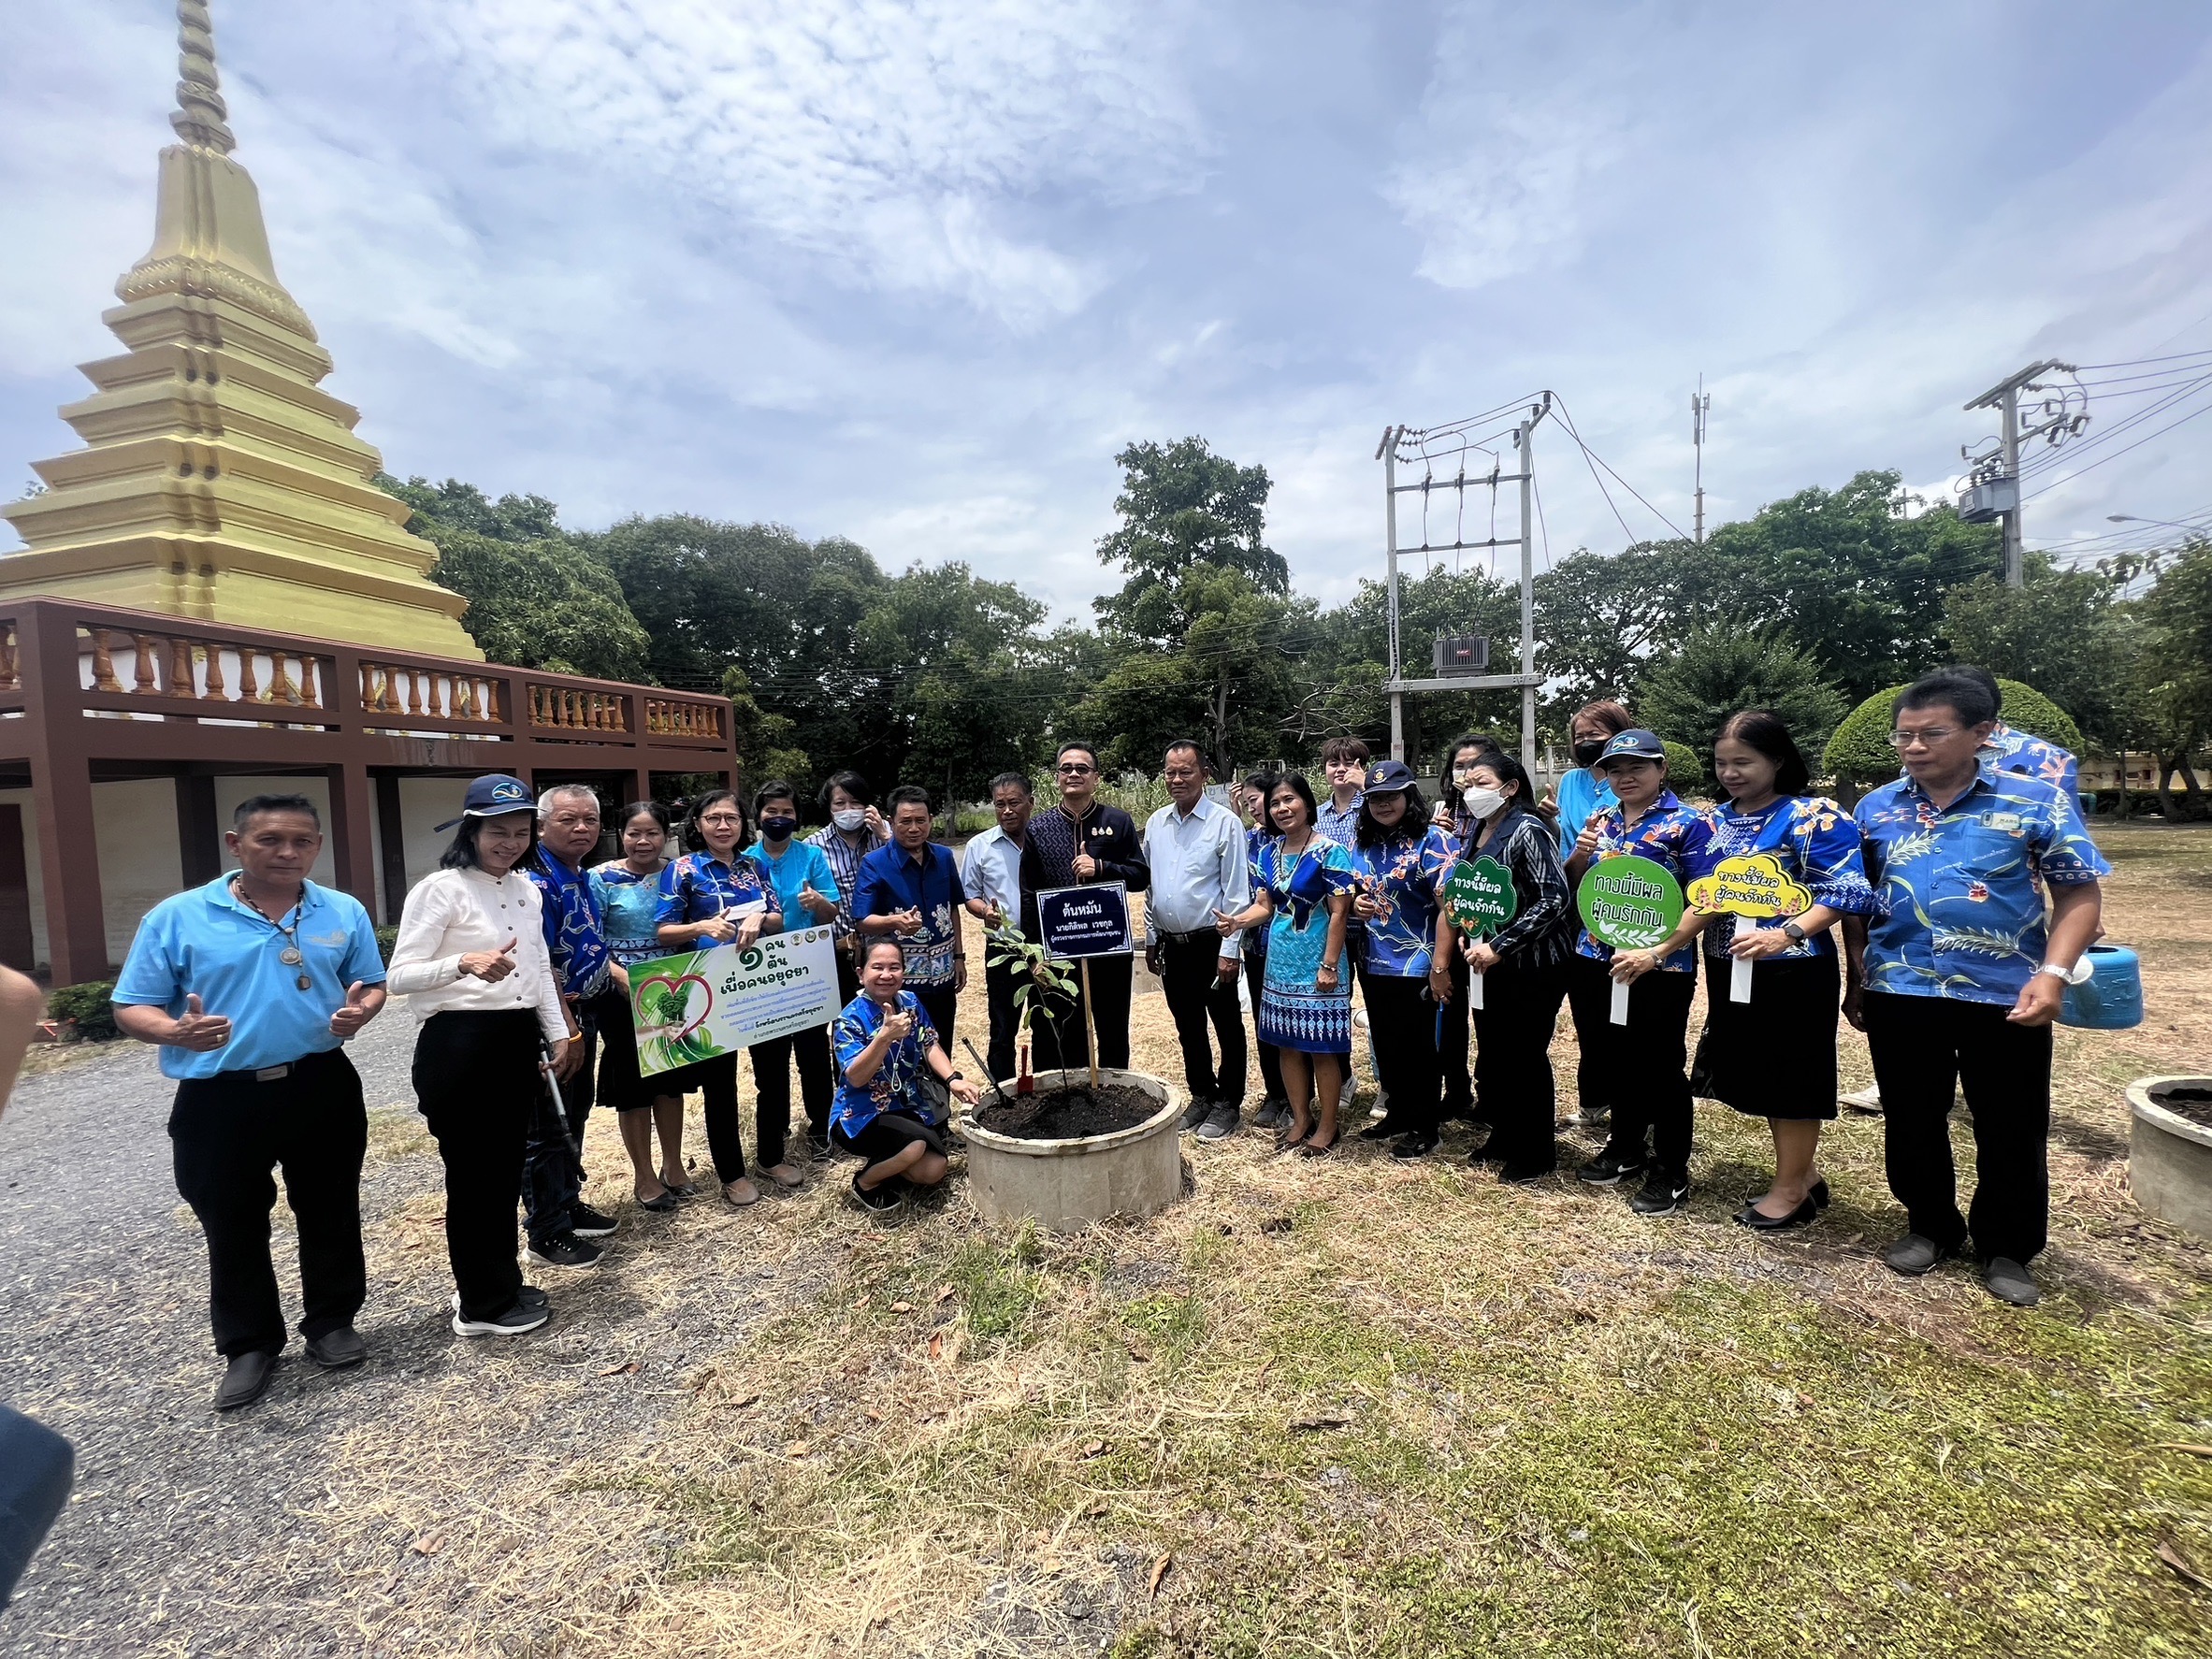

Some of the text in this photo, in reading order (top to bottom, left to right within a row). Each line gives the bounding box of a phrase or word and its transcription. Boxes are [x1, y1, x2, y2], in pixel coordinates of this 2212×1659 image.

[1453, 871, 1502, 894] ทางนี้มีผล
[1594, 871, 1664, 901] ทางนี้มีผล
[1717, 866, 1781, 887] ทางนี้มีผล
[1453, 893, 1505, 916] ผู้คนรักกัน
[1713, 885, 1782, 906] ผู้คนรักกัน
[1063, 900, 1102, 917] ต้นหมัน
[1591, 897, 1663, 928] ผู้คนรักกัน
[765, 940, 786, 952] คน
[767, 954, 788, 970] ต้น
[720, 965, 809, 995] เพื่อคนอยุธยา
